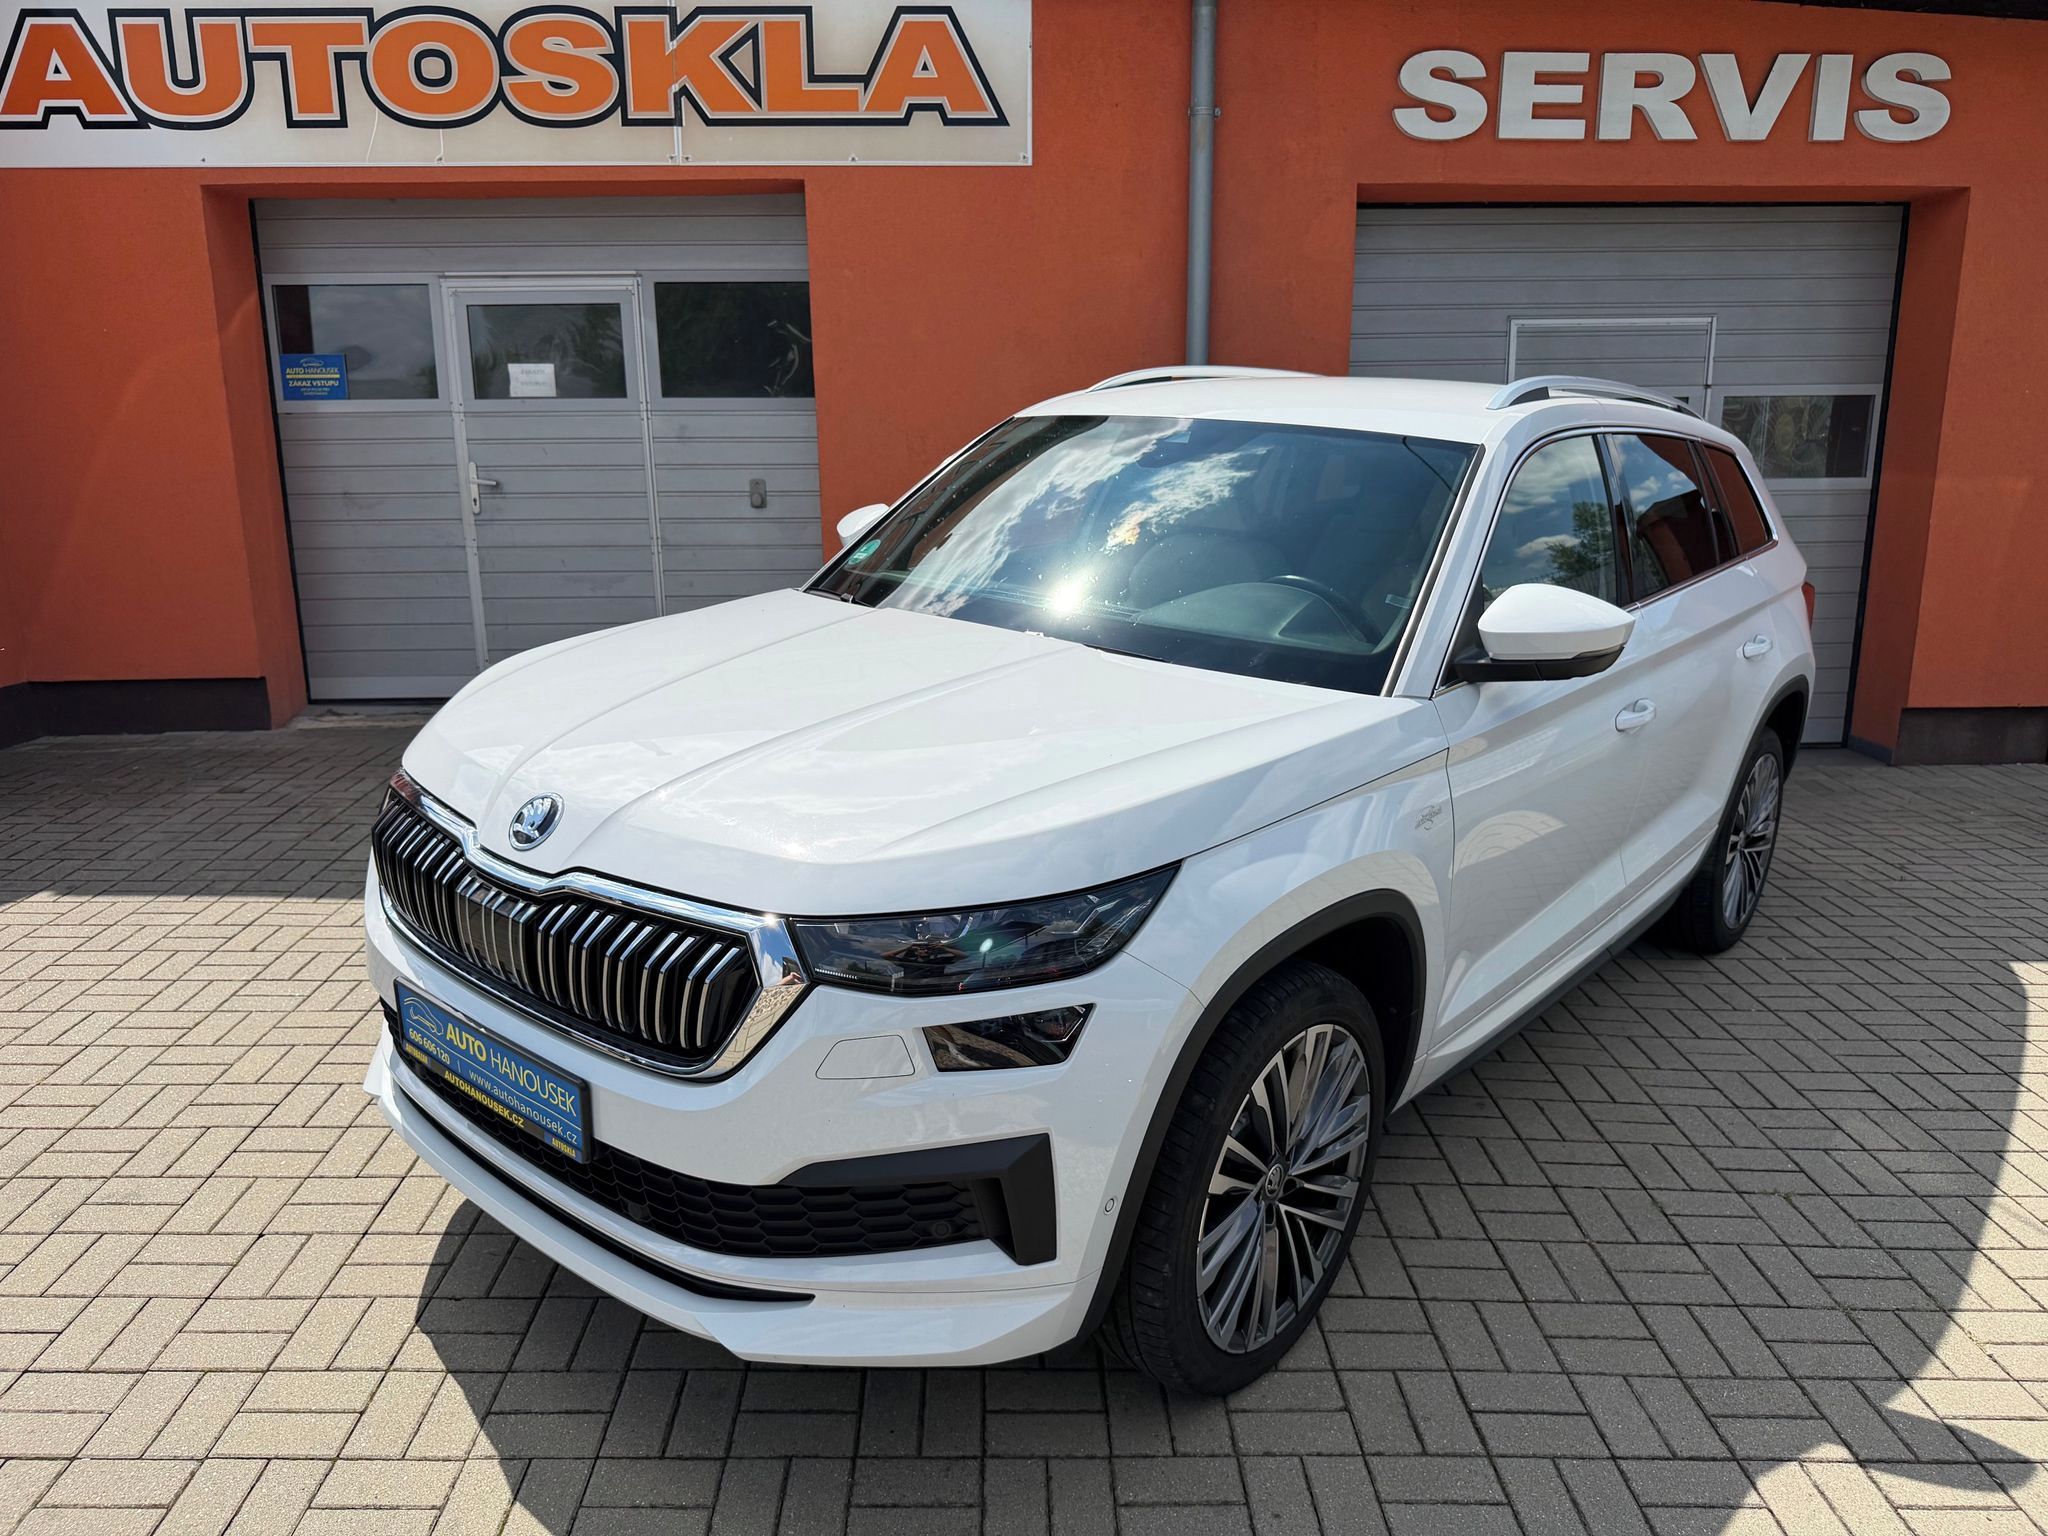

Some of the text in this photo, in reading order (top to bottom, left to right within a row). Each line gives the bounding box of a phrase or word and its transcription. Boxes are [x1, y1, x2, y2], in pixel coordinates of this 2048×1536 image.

[0, 6, 1009, 130] AUTOSKLA
[1392, 50, 1952, 142] SERVIS
[409, 1028, 578, 1145] 606 606 120 www.autohanousek.cz
[446, 1022, 577, 1117] AUTO HANOUSEK
